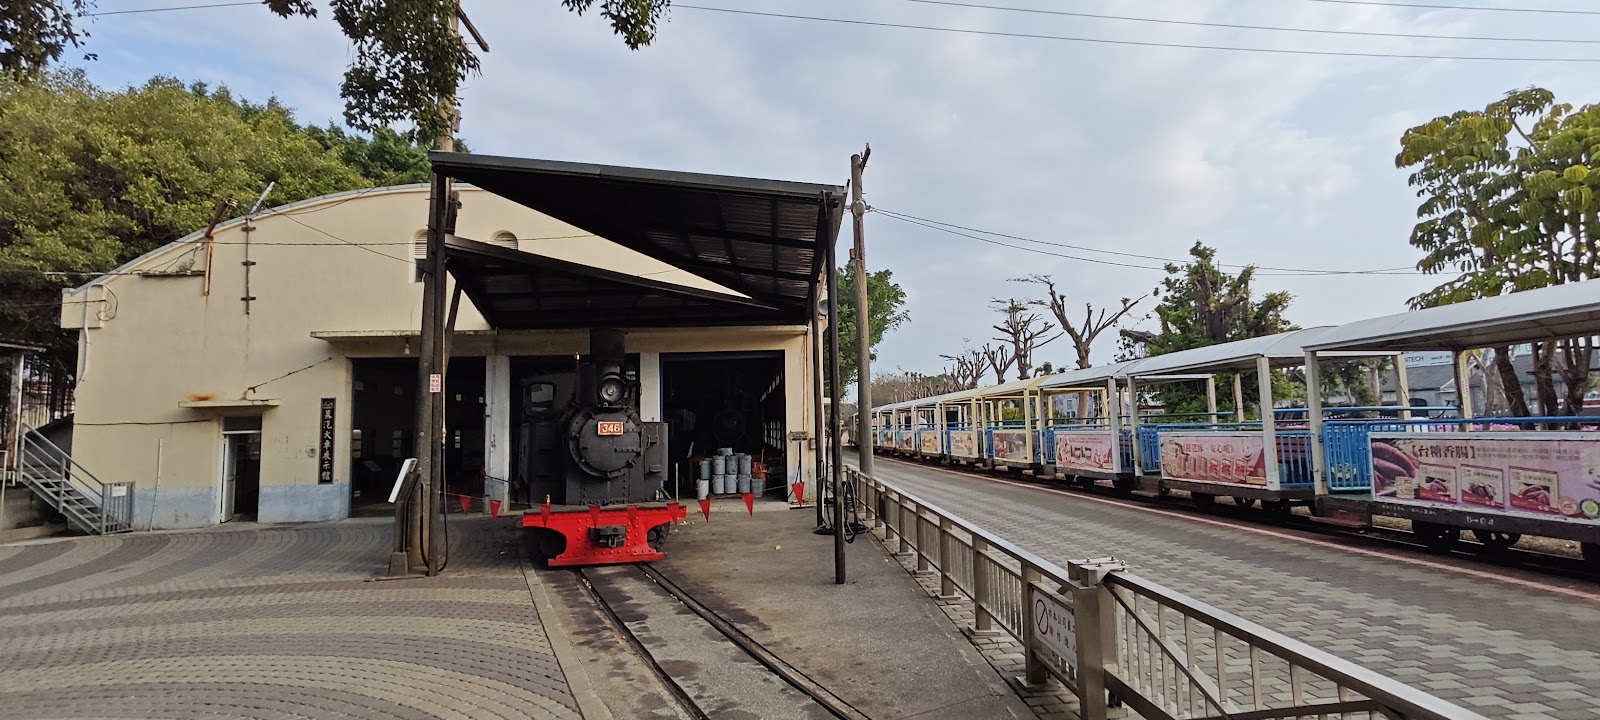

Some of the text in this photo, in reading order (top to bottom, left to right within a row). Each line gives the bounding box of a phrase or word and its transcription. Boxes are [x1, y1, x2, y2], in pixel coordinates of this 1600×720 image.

[321, 409, 333, 481] 蒸汽火車展示館
[602, 423, 621, 433] 346
